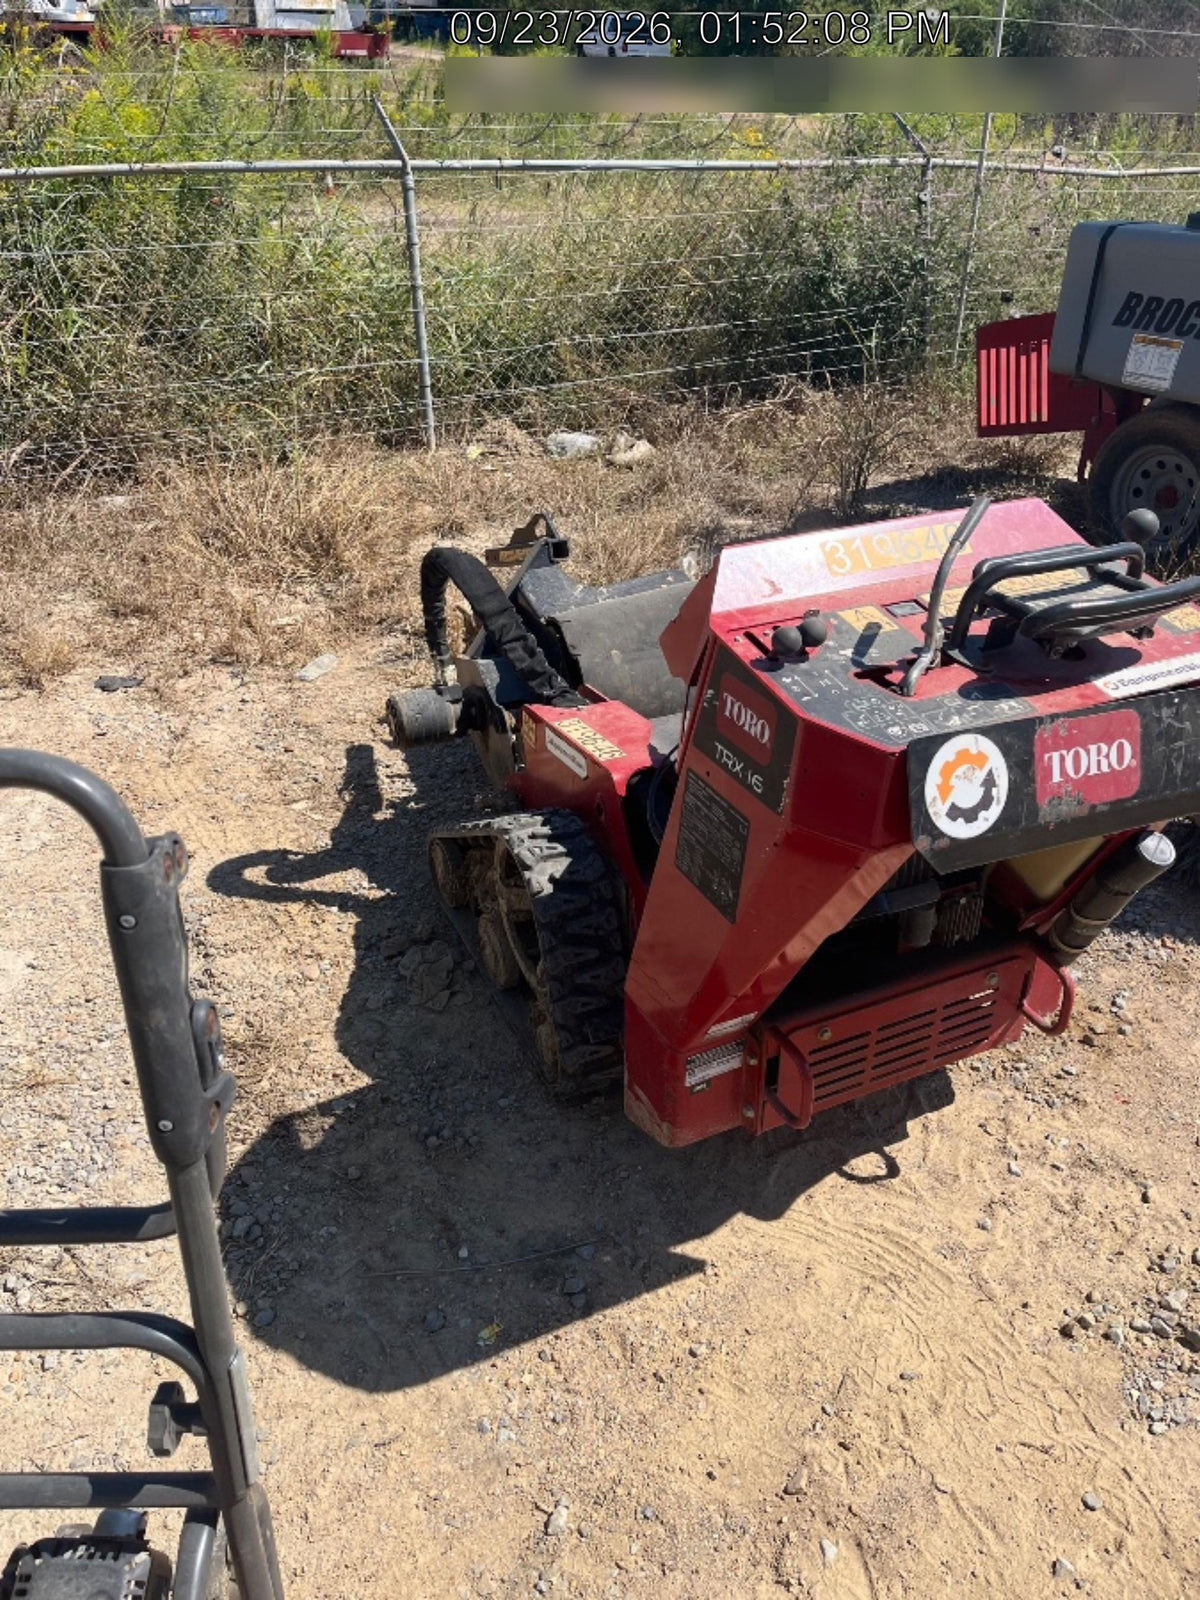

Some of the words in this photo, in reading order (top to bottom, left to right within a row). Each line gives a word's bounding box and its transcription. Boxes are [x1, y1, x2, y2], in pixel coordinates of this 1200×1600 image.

[1112, 291, 1200, 340] BROC
[723, 692, 770, 745] TORO
[1043, 738, 1131, 783] TORO
